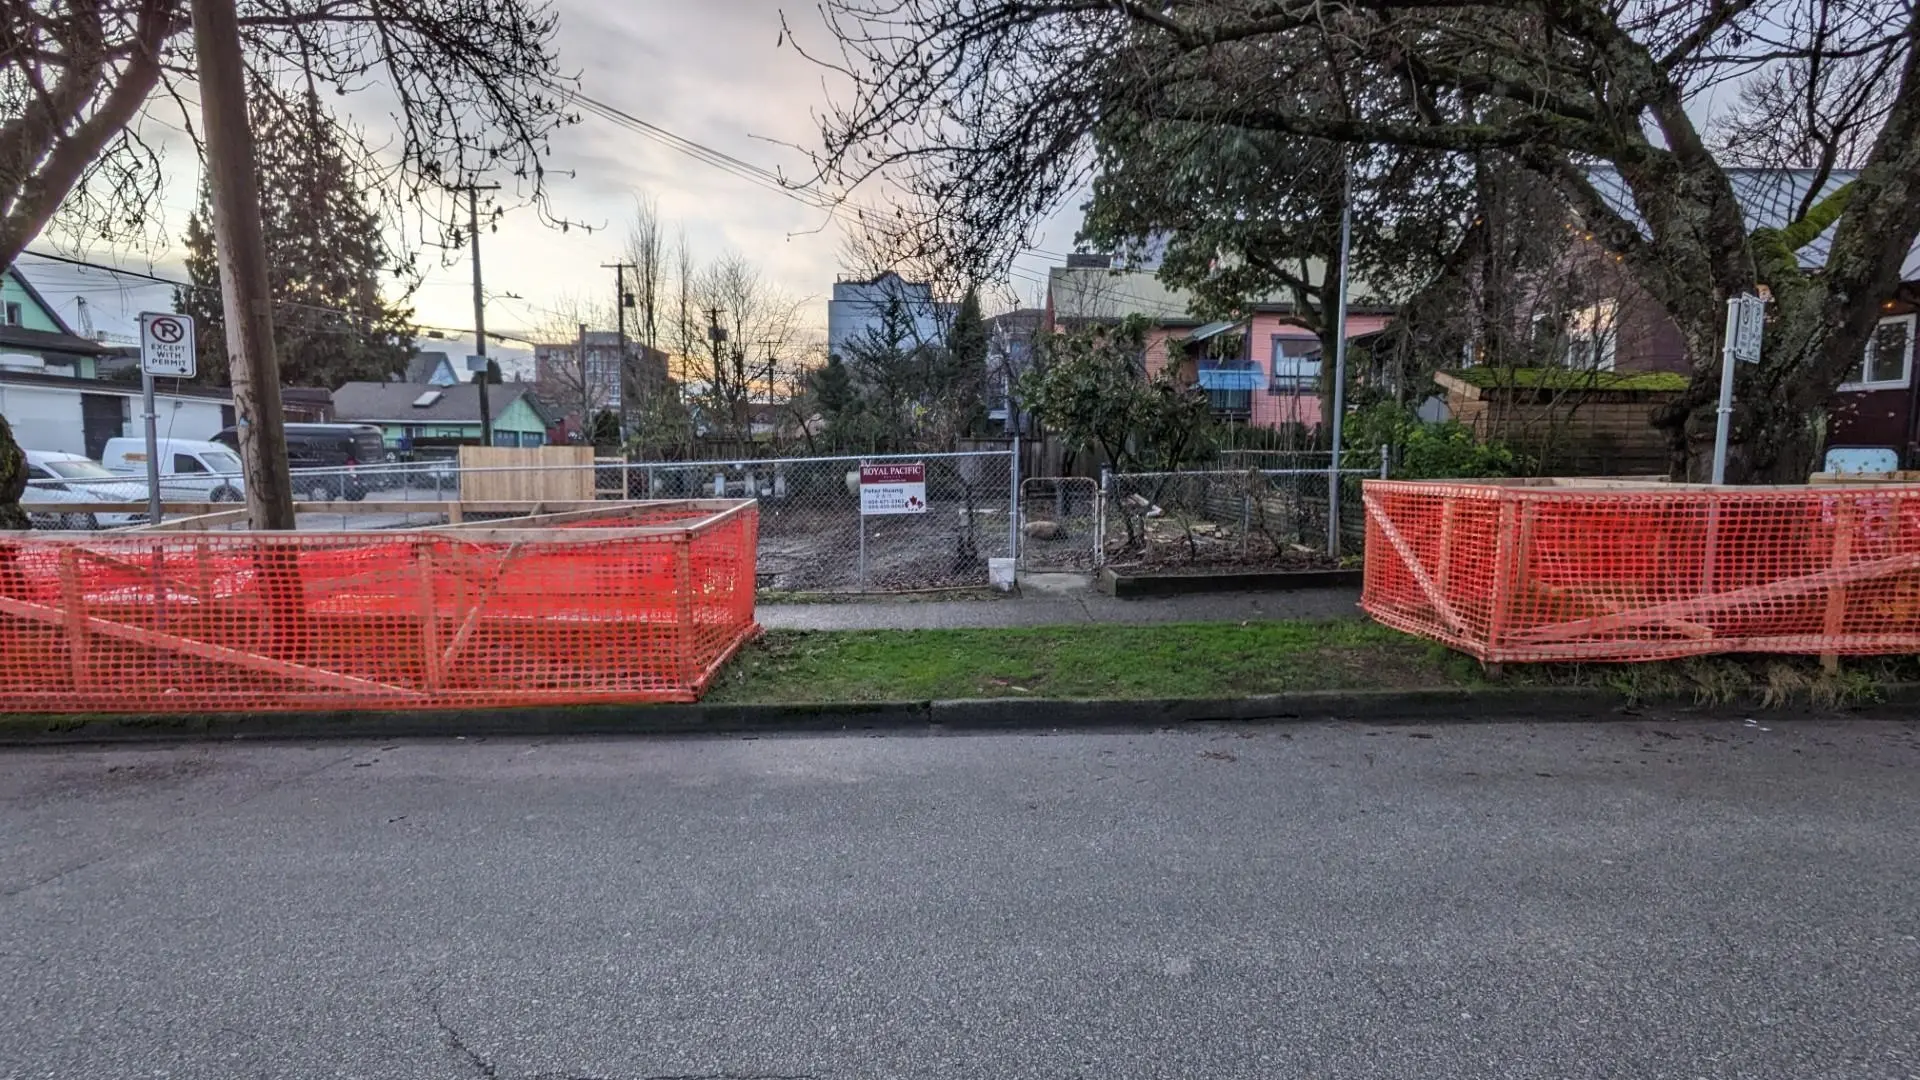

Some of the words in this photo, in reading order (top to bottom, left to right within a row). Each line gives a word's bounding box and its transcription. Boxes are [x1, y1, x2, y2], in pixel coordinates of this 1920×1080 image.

[151, 343, 186, 353] EXCEPT
[157, 351, 181, 360] WITH
[152, 358, 186, 367] PERMIT
[863, 467, 888, 476] ROYAL
[890, 466, 921, 475] PACIFIC
